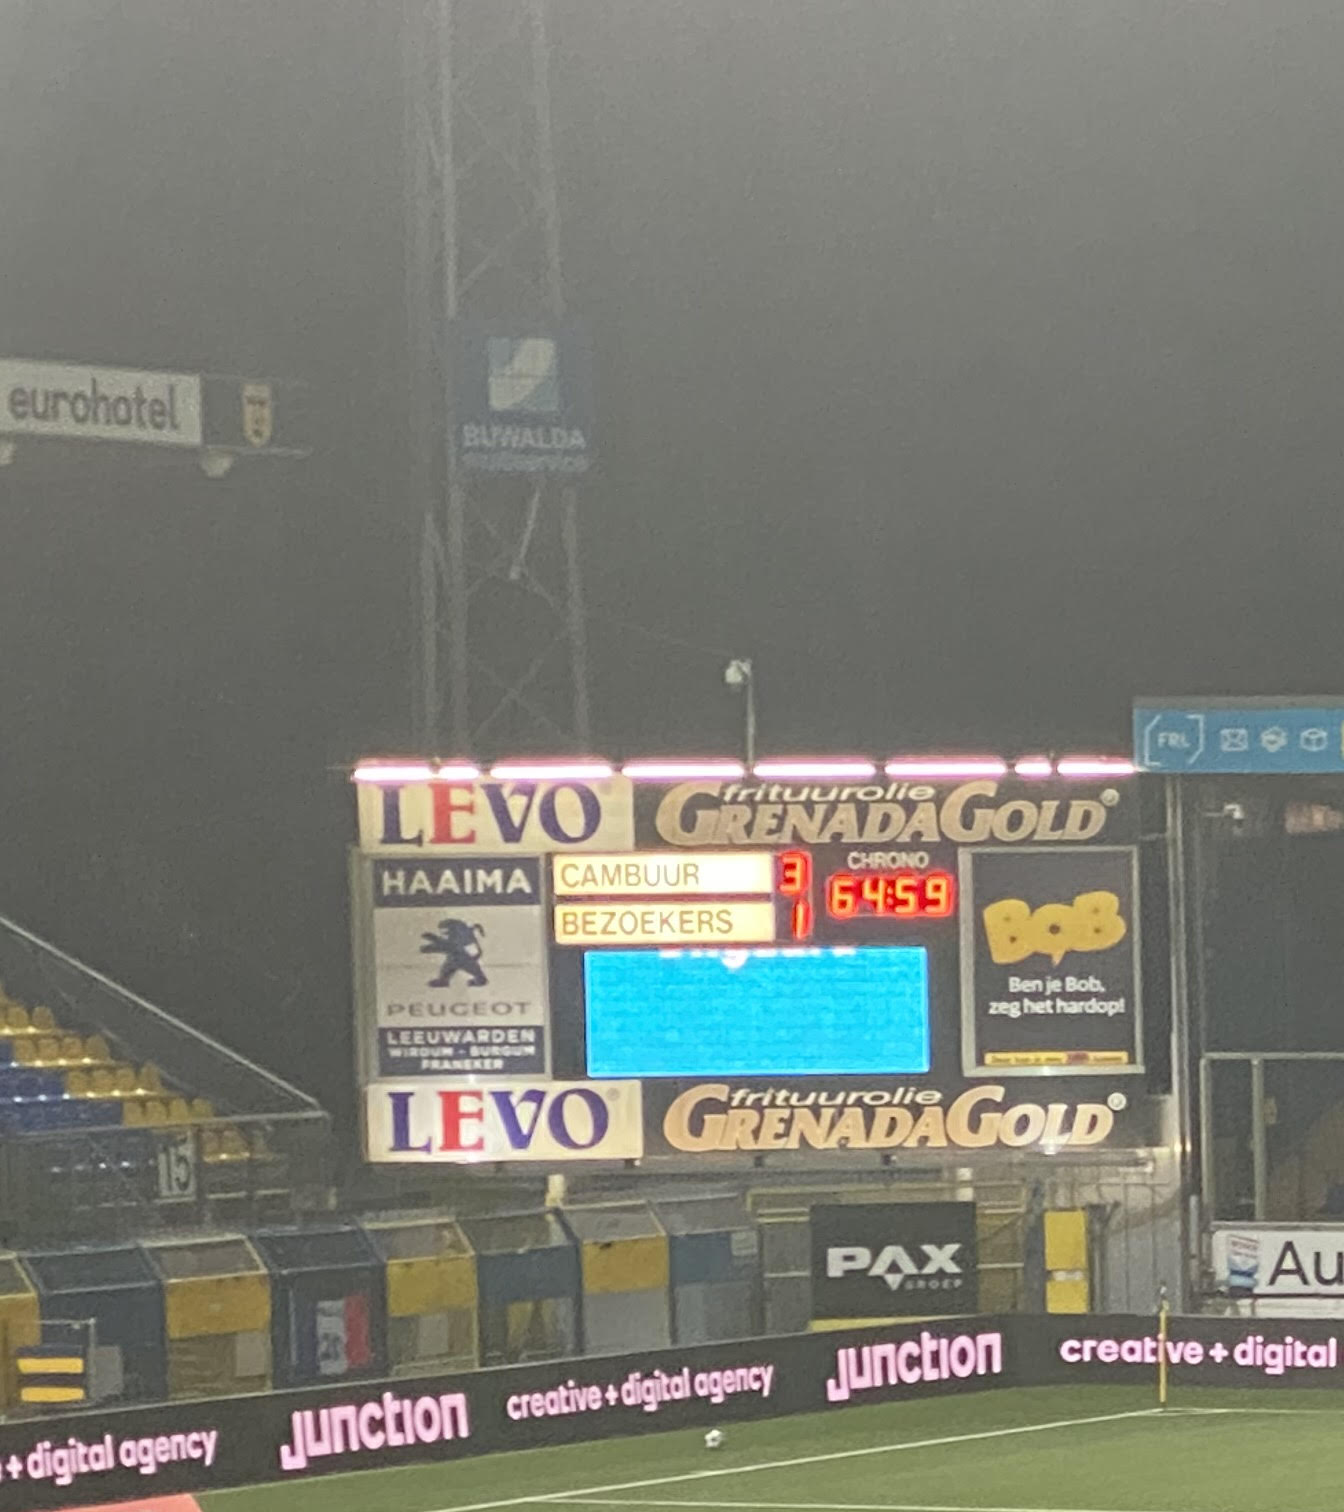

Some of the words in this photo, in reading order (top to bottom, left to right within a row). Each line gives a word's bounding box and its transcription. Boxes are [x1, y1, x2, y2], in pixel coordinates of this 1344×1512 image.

[8, 376, 181, 430] eurohotel
[1157, 731, 1190, 748] FRL
[723, 782, 936, 803] frituurolie
[380, 782, 601, 846] LEVO
[848, 852, 929, 870] CHRONO
[382, 868, 532, 896] HAAIMA
[561, 863, 700, 888] CAMBUUR
[777, 855, 808, 896] 3
[829, 873, 951, 917] 64:59
[562, 909, 734, 937] BEZOEKERS
[1008, 976, 1043, 993] Ben
[1045, 976, 1062, 995] je
[387, 1001, 531, 1017] PEUGEOT
[989, 1001, 1021, 1018] zeg
[1023, 998, 1053, 1014] het
[1055, 998, 1126, 1017] hardop!
[387, 1028, 536, 1046] LEEUWARDEN
[727, 1086, 943, 1107] frituurolie
[387, 1087, 610, 1155] LEVO
[827, 1243, 963, 1279] PAX
[1060, 1333, 1203, 1364] creative
[1234, 1335, 1337, 1375] digital
[506, 1378, 601, 1421] creative
[621, 1367, 691, 1412] digital
[694, 1363, 774, 1402] agency
[27, 1434, 115, 1486] digital
[119, 1430, 218, 1475] agency
